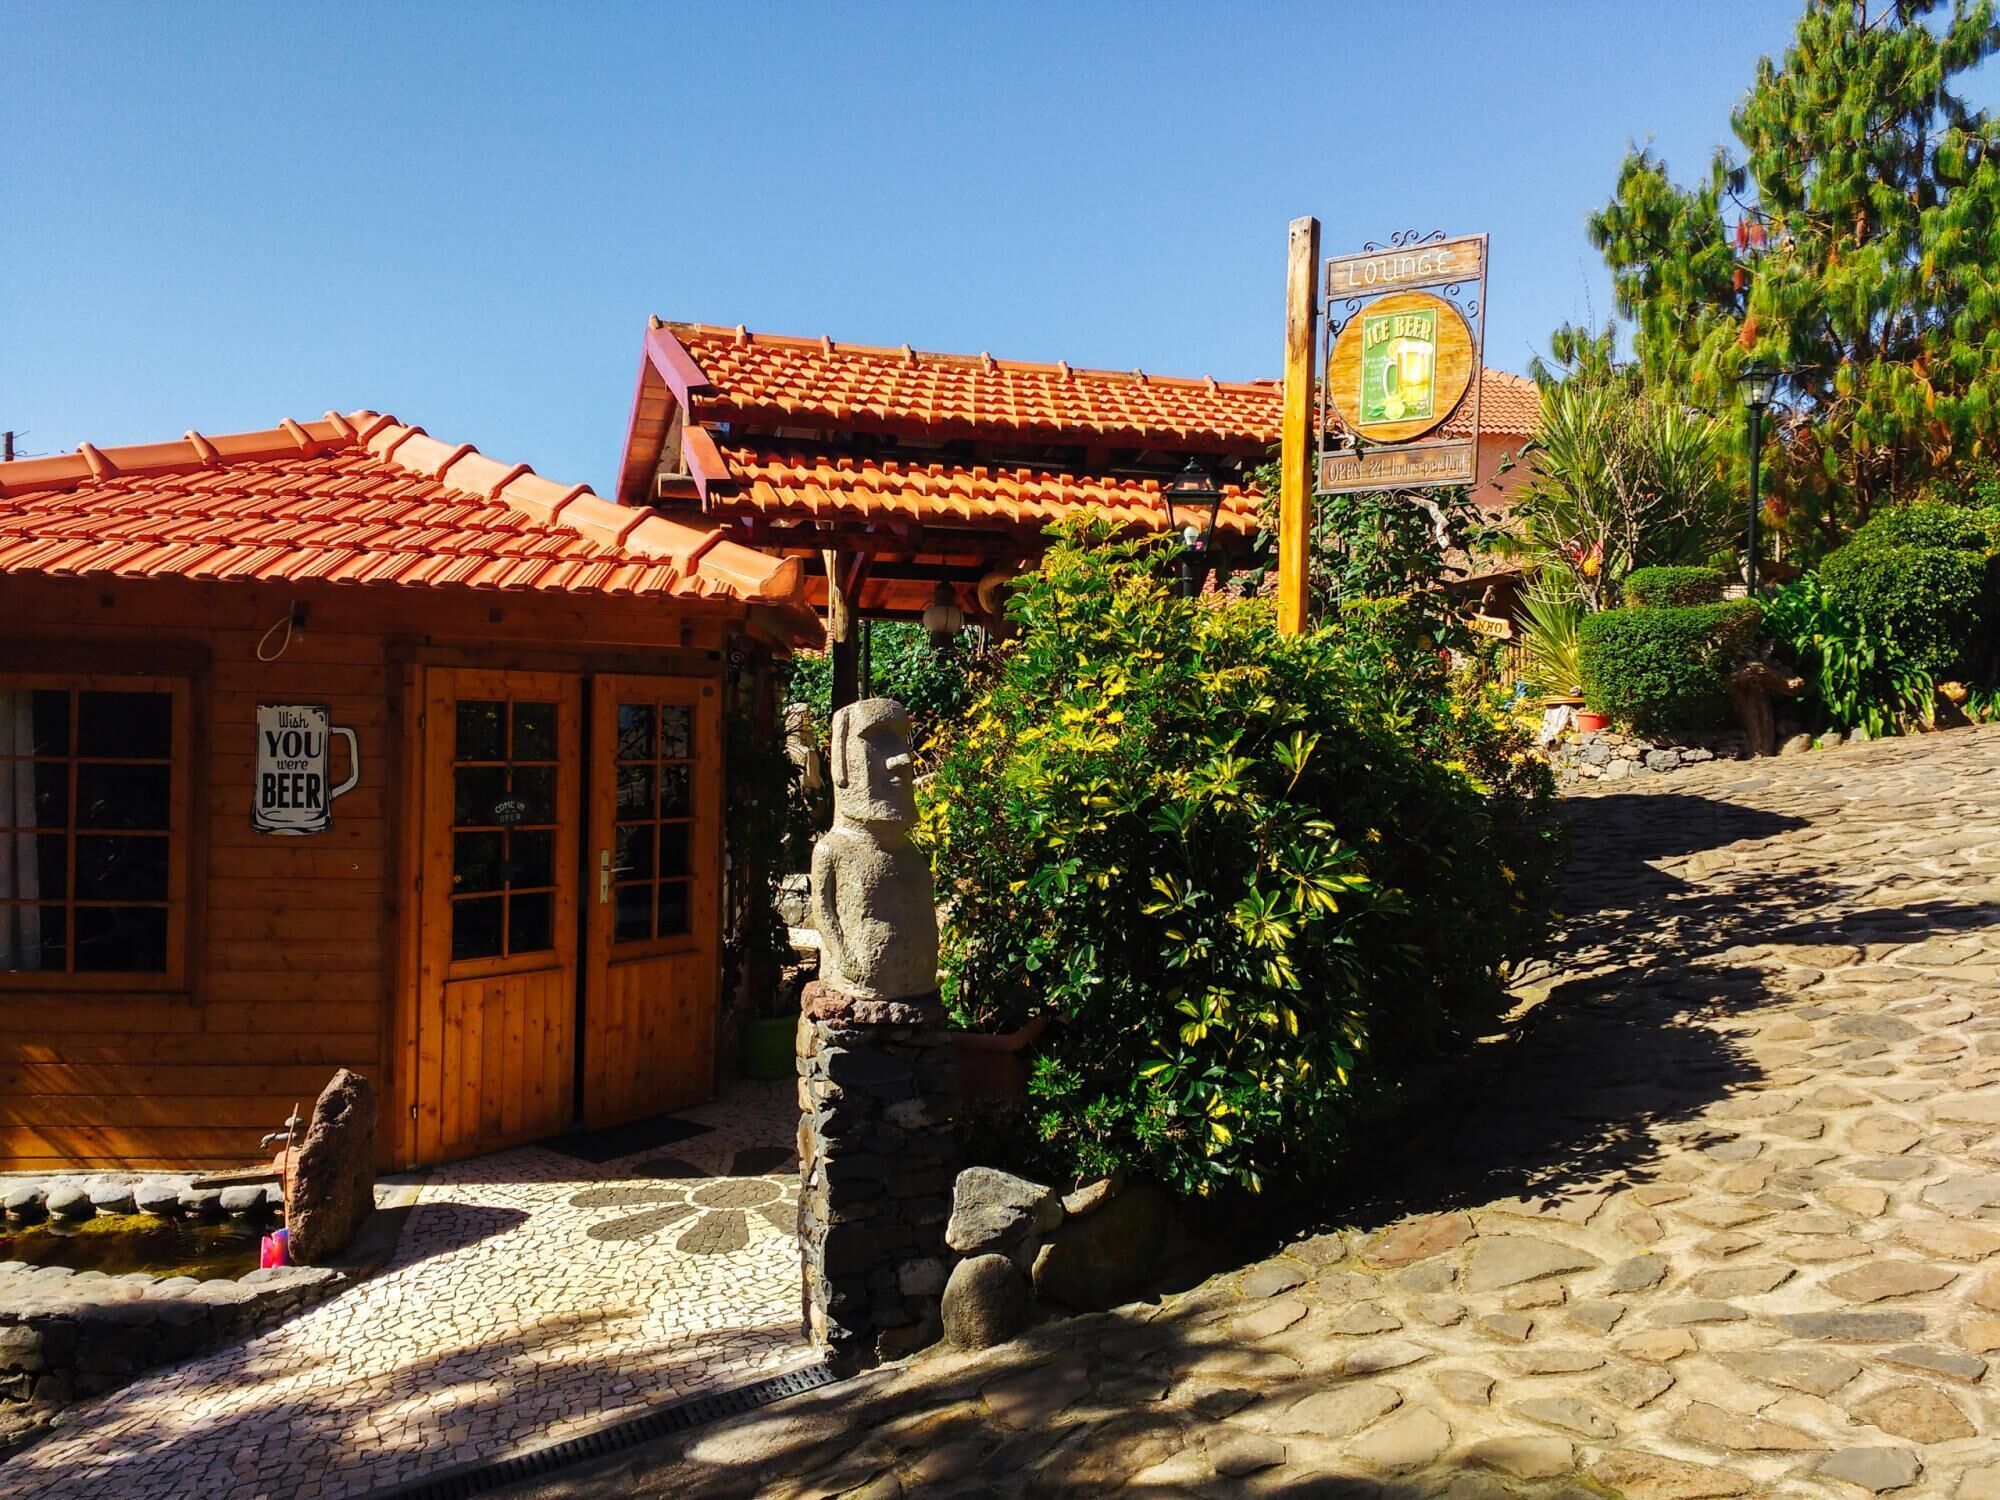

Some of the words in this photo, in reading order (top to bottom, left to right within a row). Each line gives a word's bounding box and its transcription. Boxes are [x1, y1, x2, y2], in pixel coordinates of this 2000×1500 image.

[1366, 319, 1390, 350] ICE
[1394, 315, 1432, 342] BEER
[1329, 460, 1363, 483] OPEN
[1369, 459, 1385, 479] 24
[1391, 457, 1420, 477] hours
[278, 711, 309, 729] Wish
[265, 730, 321, 758] YOU
[277, 760, 309, 770] were
[262, 772, 321, 808] BEER
[495, 800, 516, 814] COME
[516, 801, 526, 812] IN
[499, 813, 521, 822] OPEN
